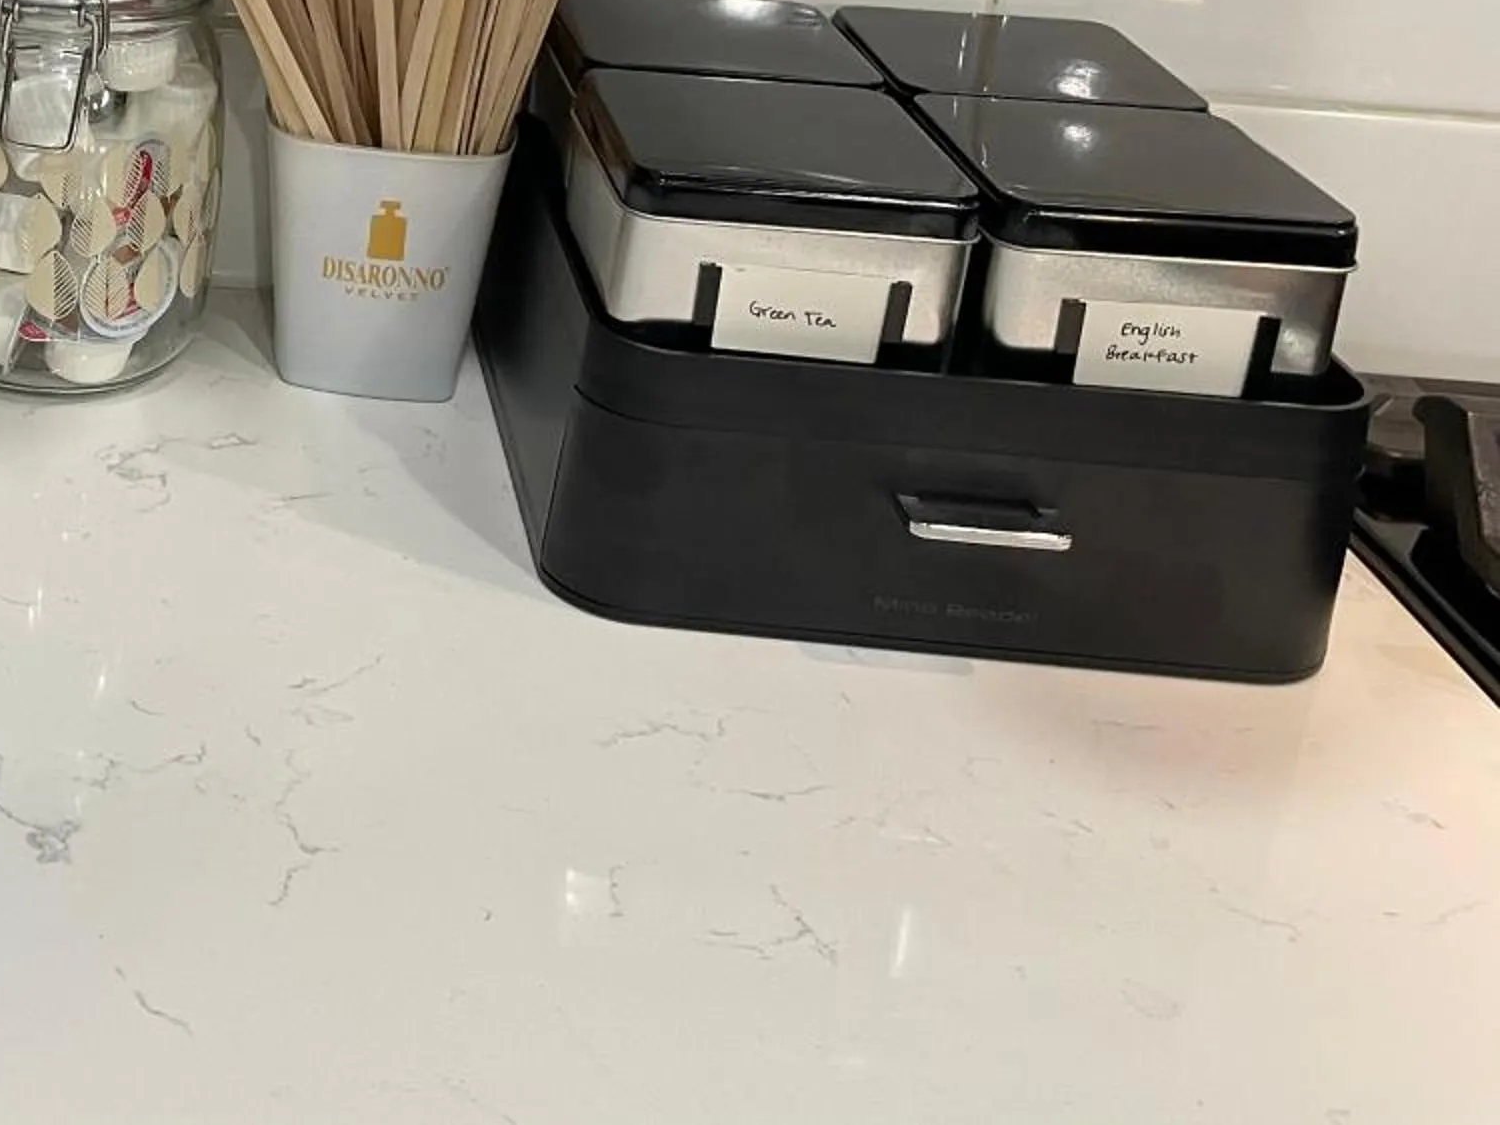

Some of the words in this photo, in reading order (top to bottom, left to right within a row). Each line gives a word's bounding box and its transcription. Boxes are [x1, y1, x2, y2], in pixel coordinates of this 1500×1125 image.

[322, 254, 448, 292] DISARONNO
[344, 284, 418, 301] VELVET
[749, 300, 796, 320] Green
[803, 311, 837, 328] Tea
[1120, 322, 1181, 346] English
[1105, 344, 1199, 364] Breakfast
